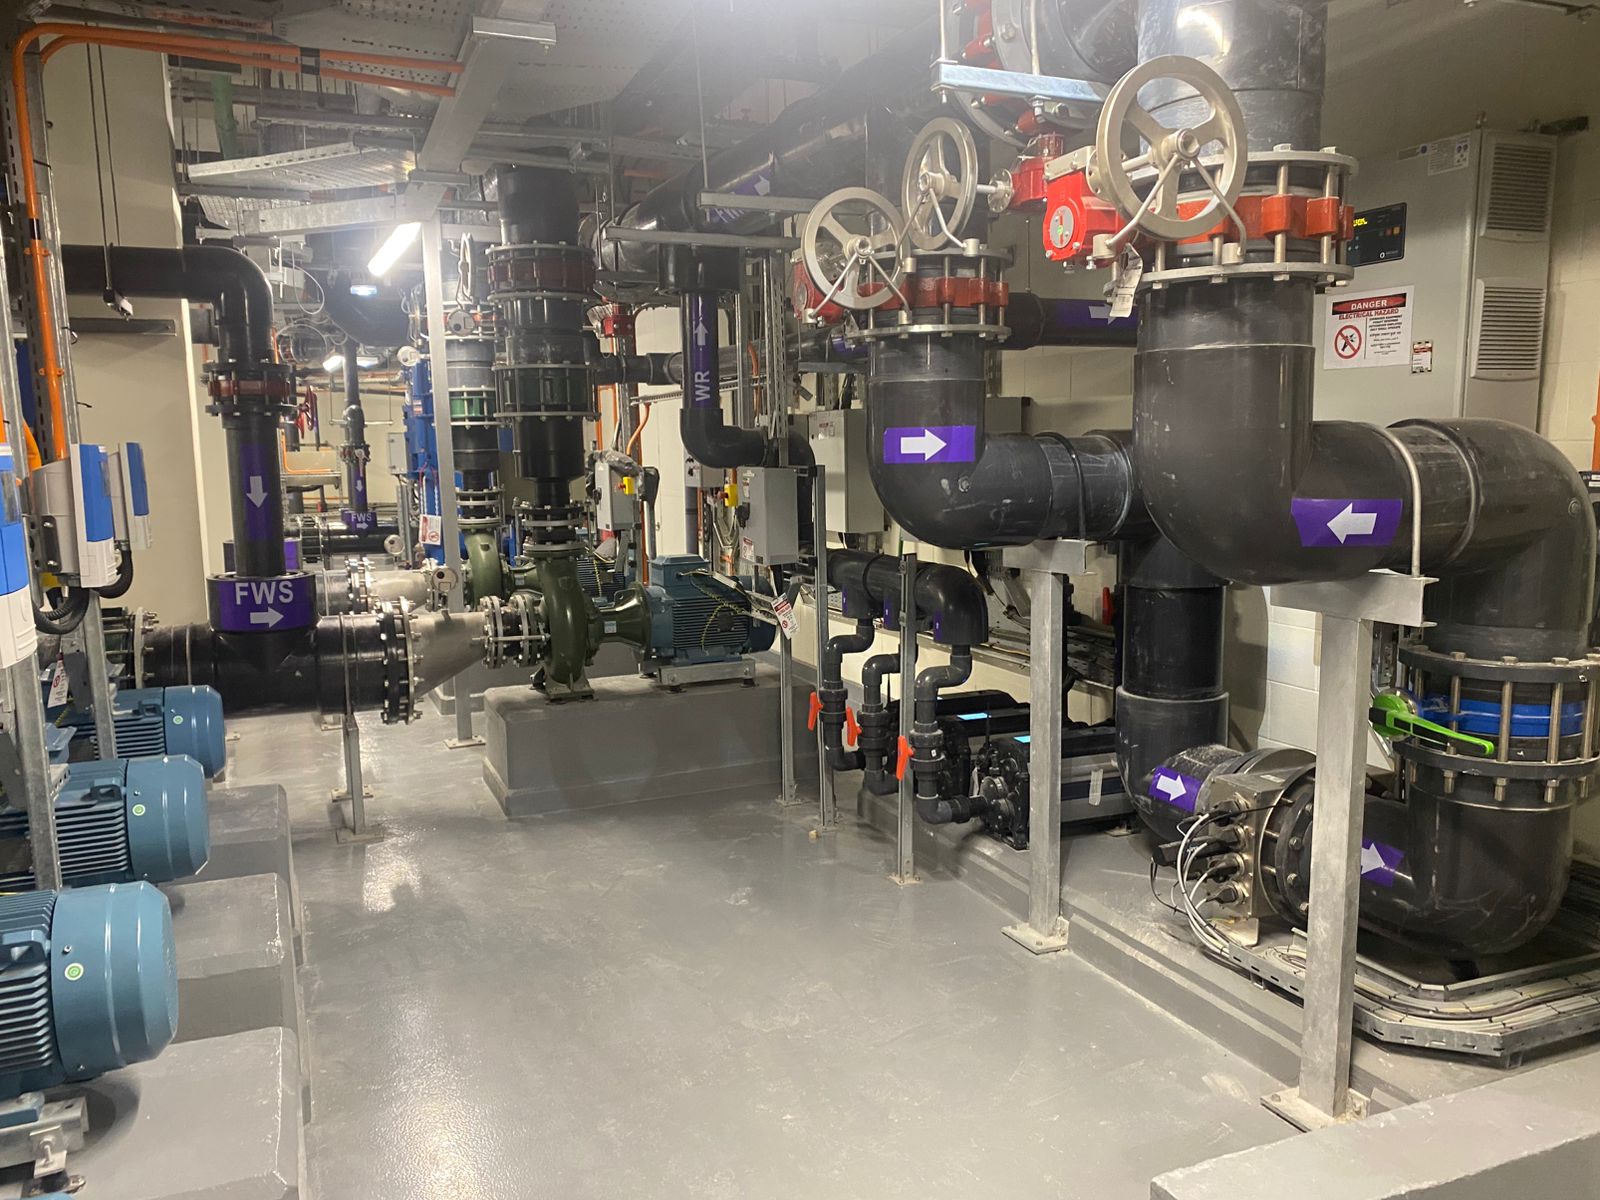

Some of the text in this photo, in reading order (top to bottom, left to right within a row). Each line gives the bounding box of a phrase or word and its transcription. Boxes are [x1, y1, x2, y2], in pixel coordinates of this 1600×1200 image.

[1351, 299, 1388, 310] DANGER
[1338, 308, 1400, 320] ELECTRICAL HAZARD
[694, 370, 711, 401] WR
[351, 511, 372, 522] FWS
[235, 580, 294, 605] FWS
